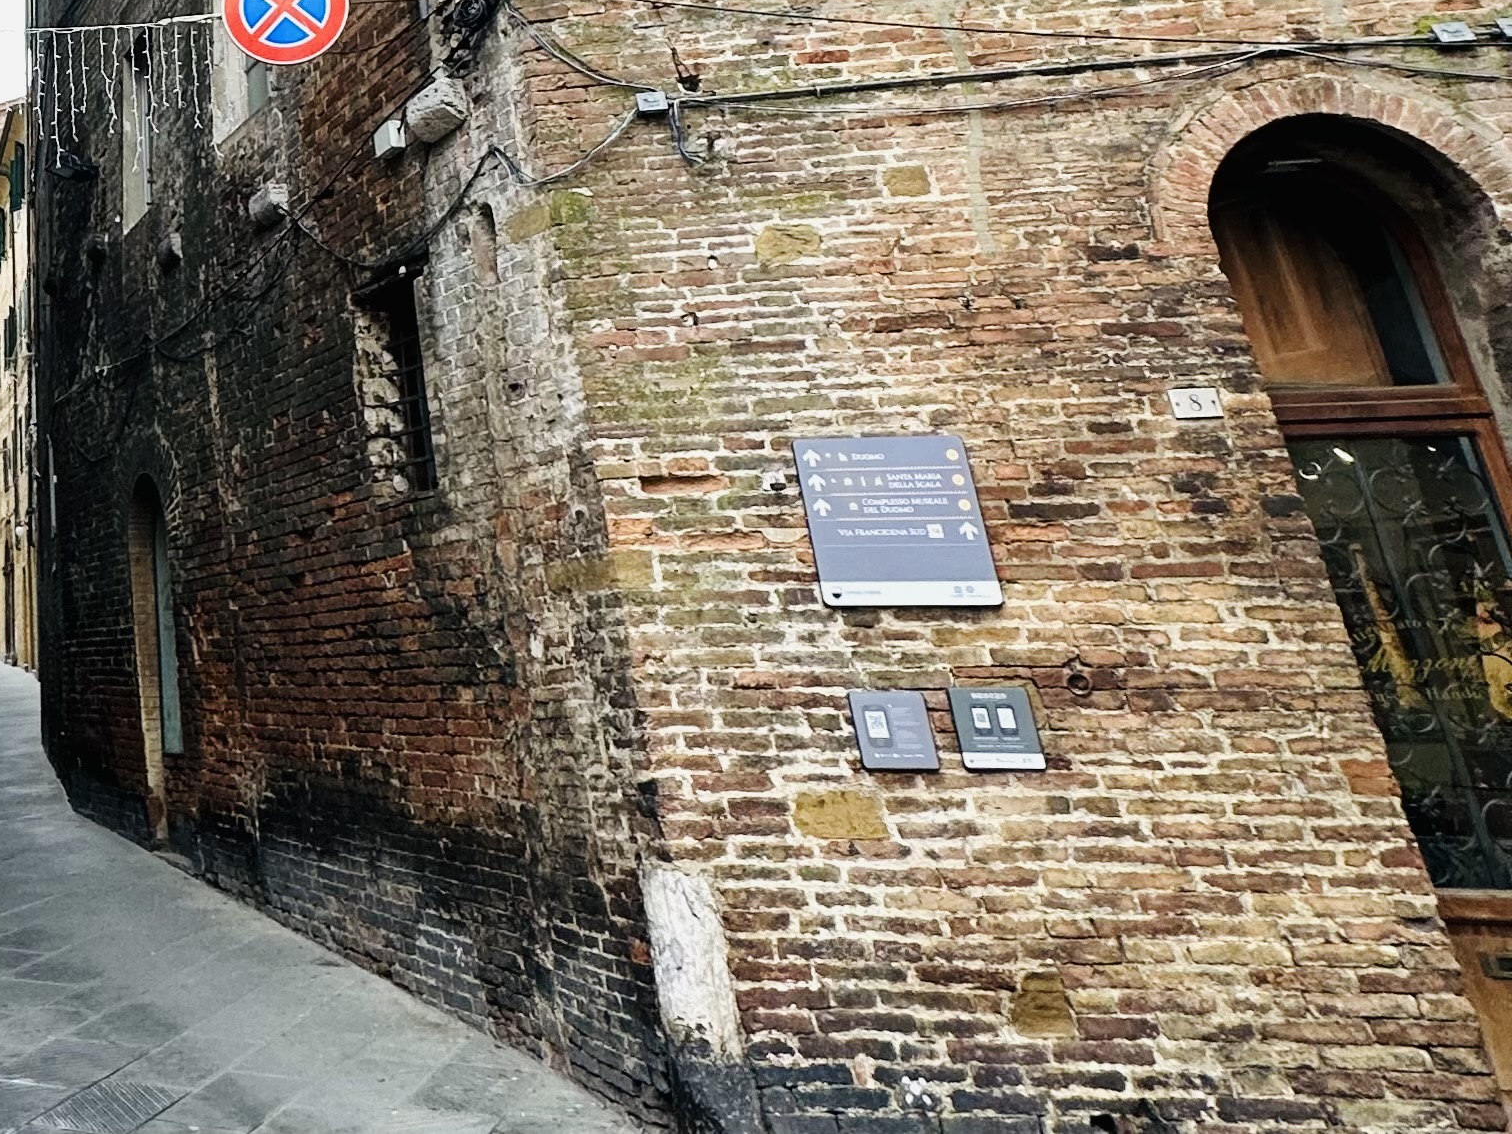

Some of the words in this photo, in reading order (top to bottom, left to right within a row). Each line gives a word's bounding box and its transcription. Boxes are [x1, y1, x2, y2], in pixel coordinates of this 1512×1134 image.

[1189, 394, 1202, 411] 8
[851, 453, 885, 461] DUOMO
[886, 473, 913, 481] SANTA
[888, 481, 915, 489] DELLA
[861, 498, 910, 506] COMPLESSO
